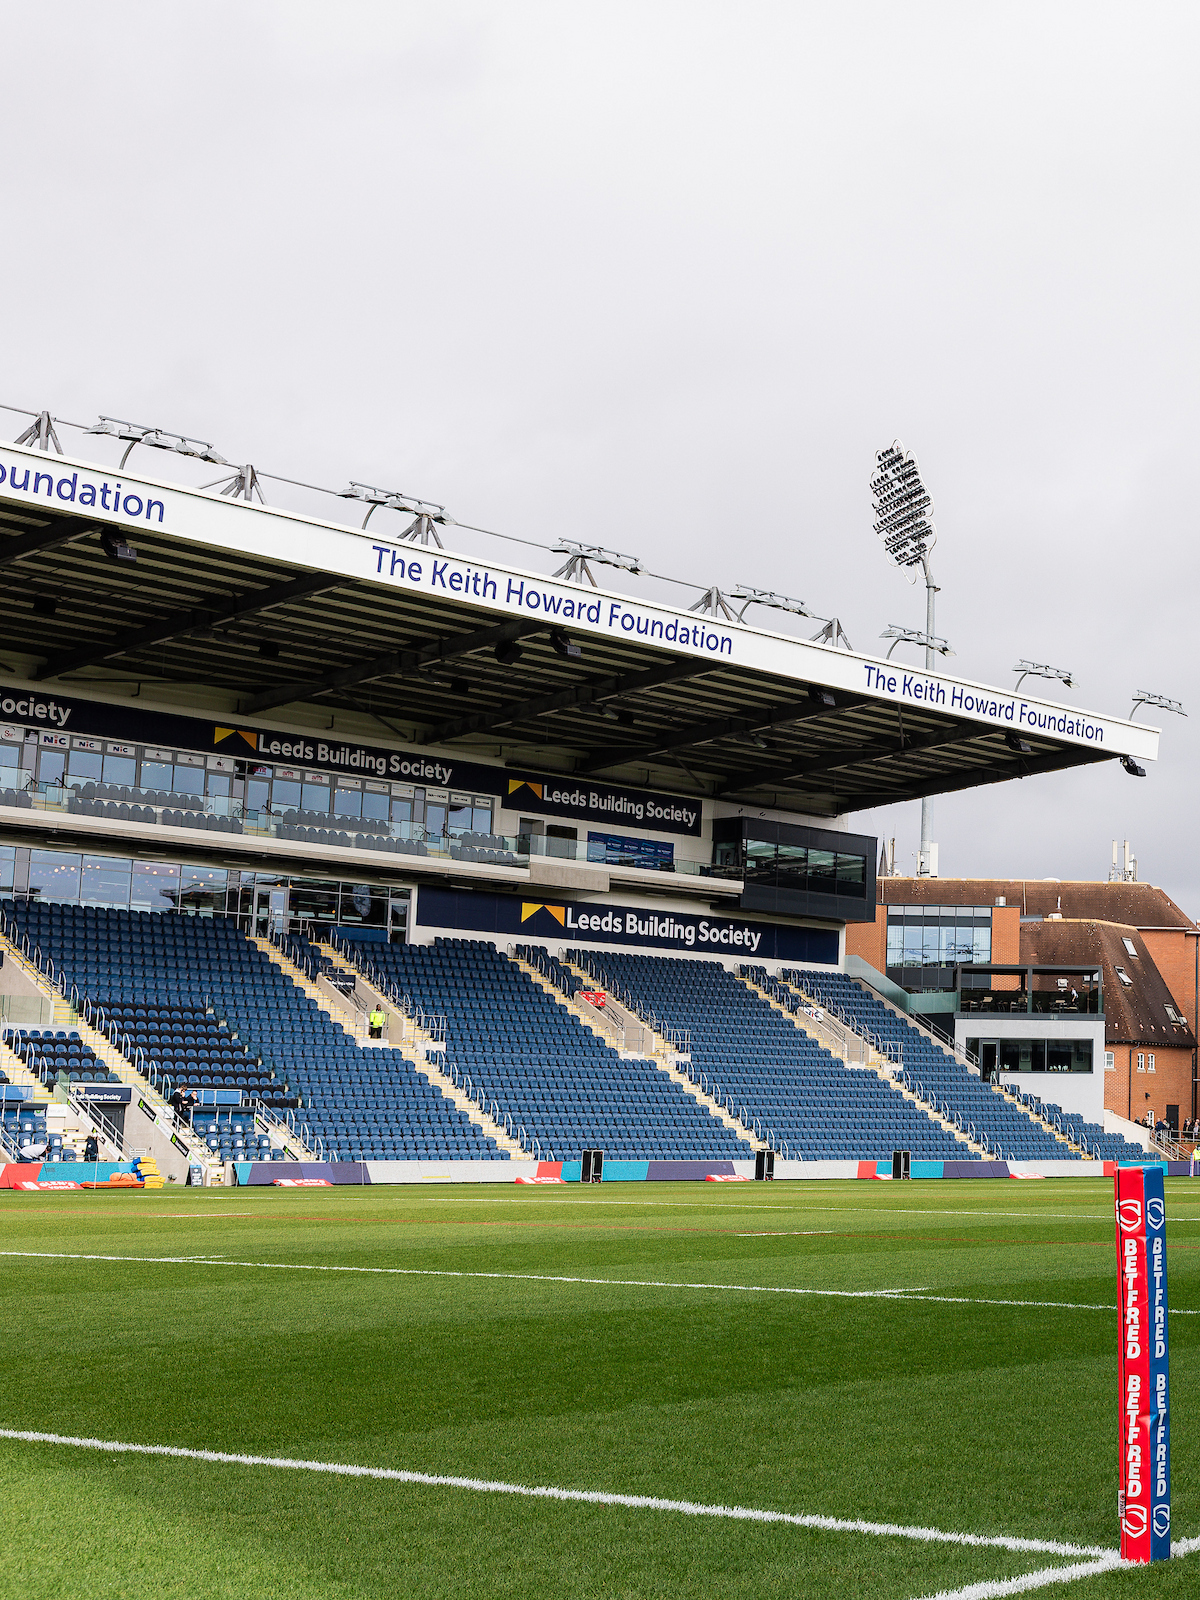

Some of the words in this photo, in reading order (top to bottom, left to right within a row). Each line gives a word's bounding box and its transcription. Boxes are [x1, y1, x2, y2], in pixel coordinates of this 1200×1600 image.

[372, 545, 422, 582] The
[432, 559, 497, 600] Keith
[507, 578, 601, 623] Howard
[608, 603, 733, 655] Foundation
[0, 693, 72, 727] ociety
[864, 665, 897, 694] The
[902, 674, 946, 706] Keith
[951, 686, 1015, 722] Howard
[1019, 704, 1105, 743] Foundation
[258, 733, 314, 761] Leeds
[317, 743, 388, 776] Building
[389, 755, 453, 785] Society
[543, 784, 587, 807] Leeds
[589, 792, 644, 820] Building
[645, 801, 697, 828] Society
[566, 907, 623, 934] Leeds
[625, 913, 697, 946] Building
[698, 922, 762, 952] Society
[1123, 1238, 1143, 1360] BETFRED
[1152, 1237, 1164, 1359] BETFRED
[1125, 1374, 1144, 1498] BETFRED
[1155, 1374, 1168, 1498] BETFRED
